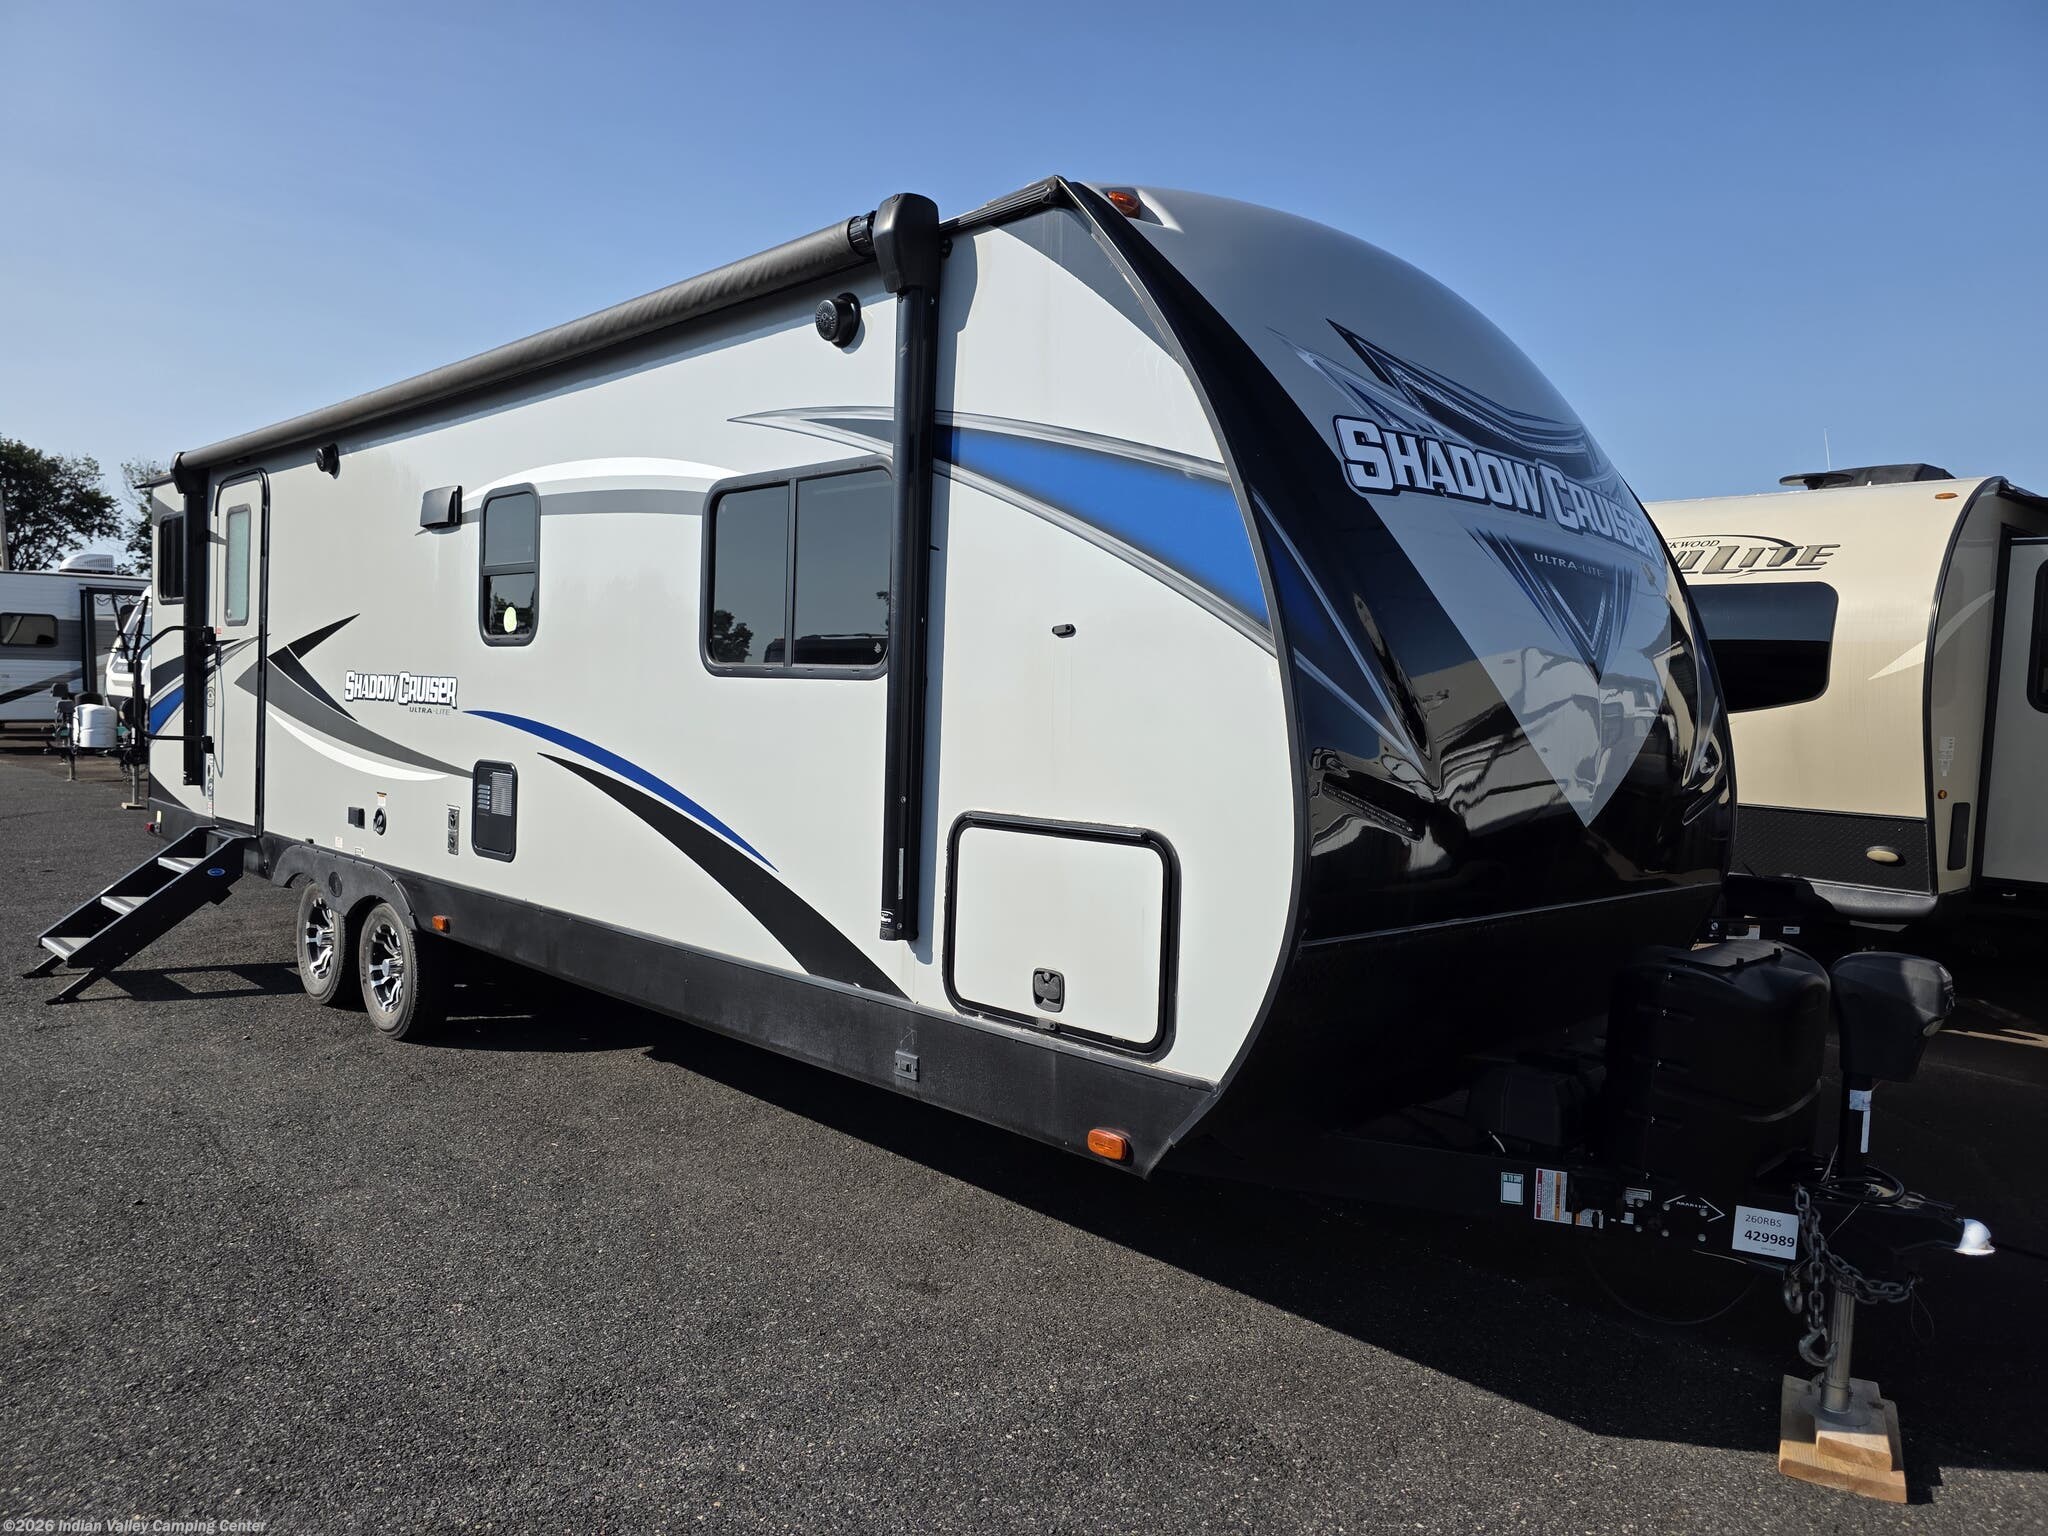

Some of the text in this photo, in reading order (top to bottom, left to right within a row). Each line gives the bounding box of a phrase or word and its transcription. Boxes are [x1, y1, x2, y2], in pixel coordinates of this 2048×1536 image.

[1334, 416, 1663, 569] SHADOW CRUISER
[1669, 540, 1720, 549] KWOOD
[1534, 552, 1605, 578] ULTRA-LITE
[345, 670, 457, 709] SHADOW CRUISER
[409, 706, 451, 716] ULTRA-LITE
[1744, 1214, 1782, 1228] 260RBS
[1744, 1230, 1795, 1248] 429989
